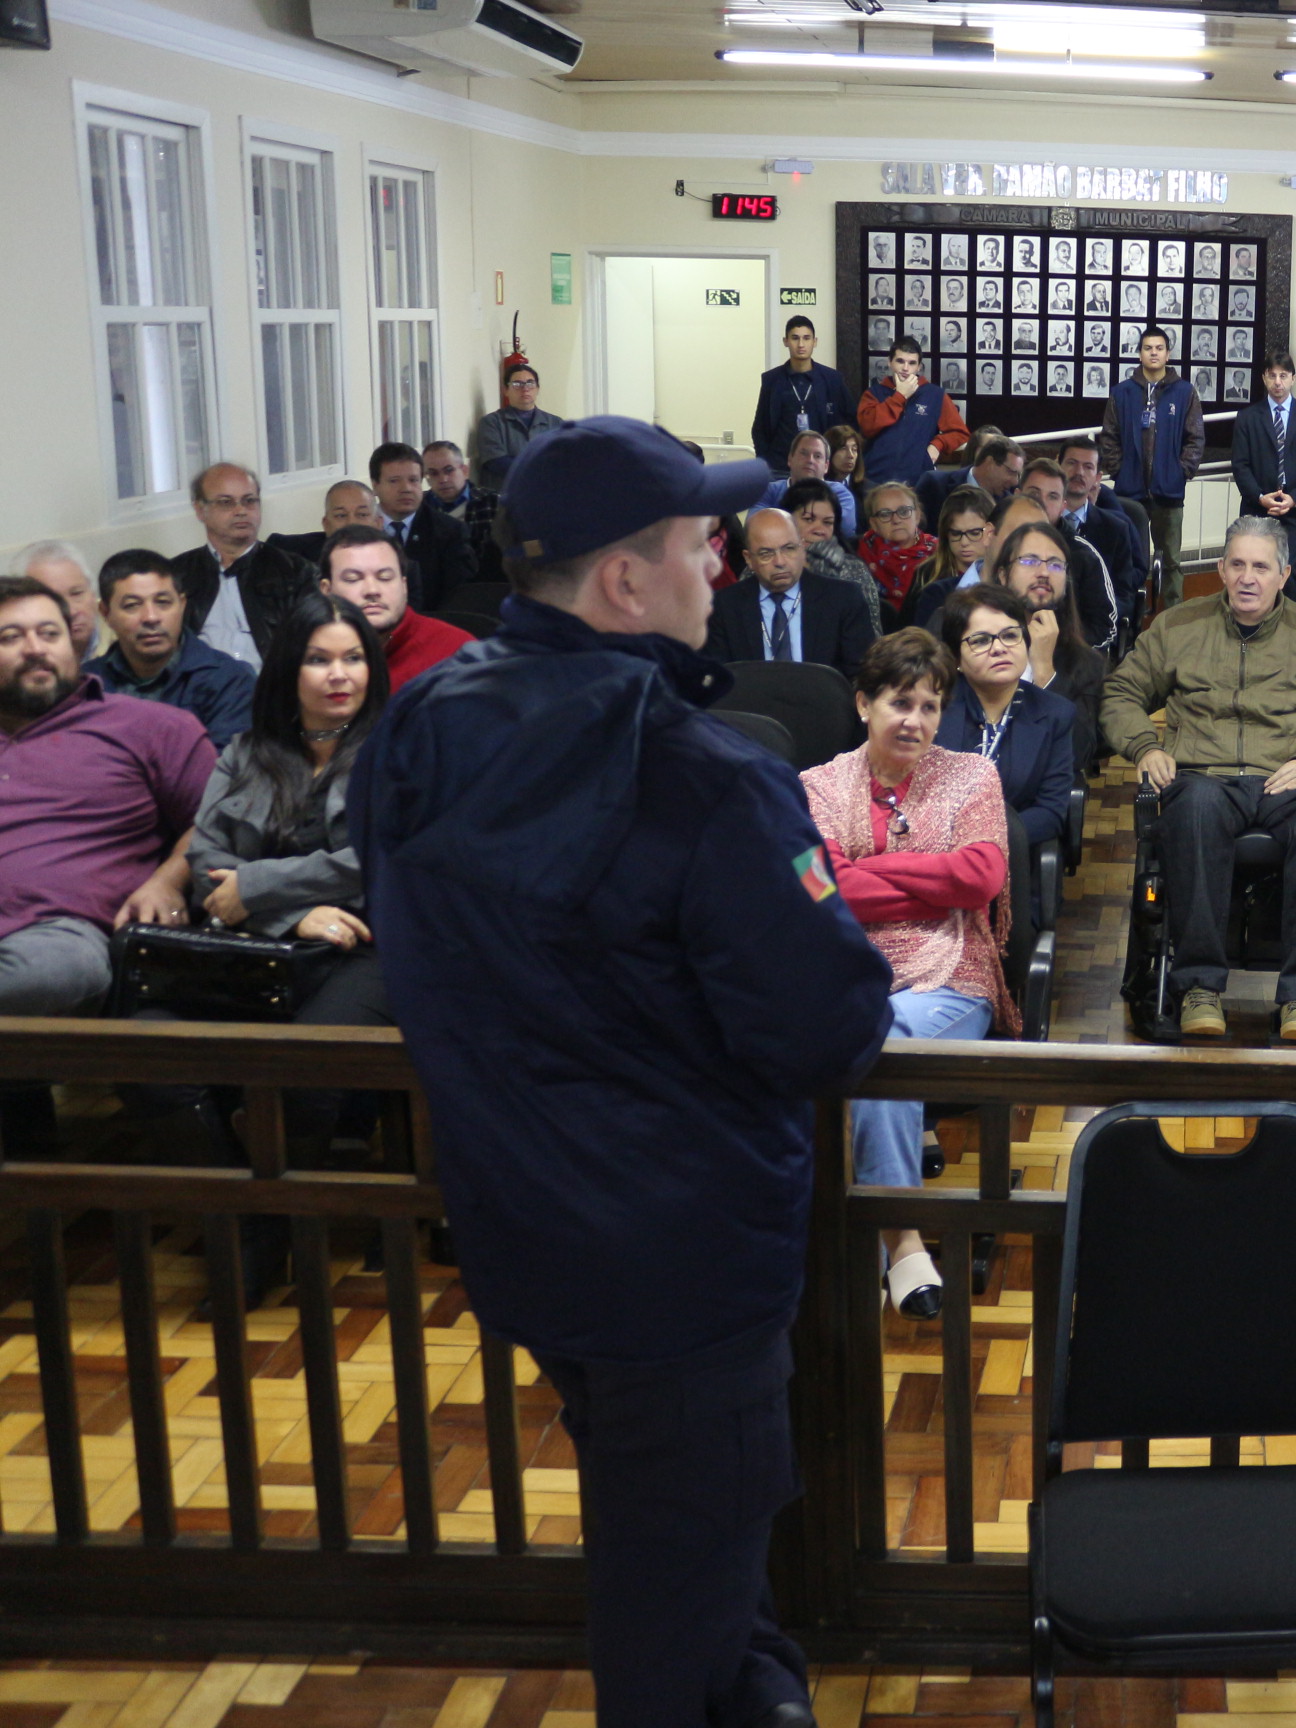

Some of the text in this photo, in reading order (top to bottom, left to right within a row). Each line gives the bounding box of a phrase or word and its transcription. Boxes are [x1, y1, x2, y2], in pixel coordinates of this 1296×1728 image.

[881, 162, 936, 195] SALA
[1167, 169, 1228, 204] FILHO
[1095, 212, 1187, 229] MUNICIPAL
[791, 288, 816, 304] SAÍDA
